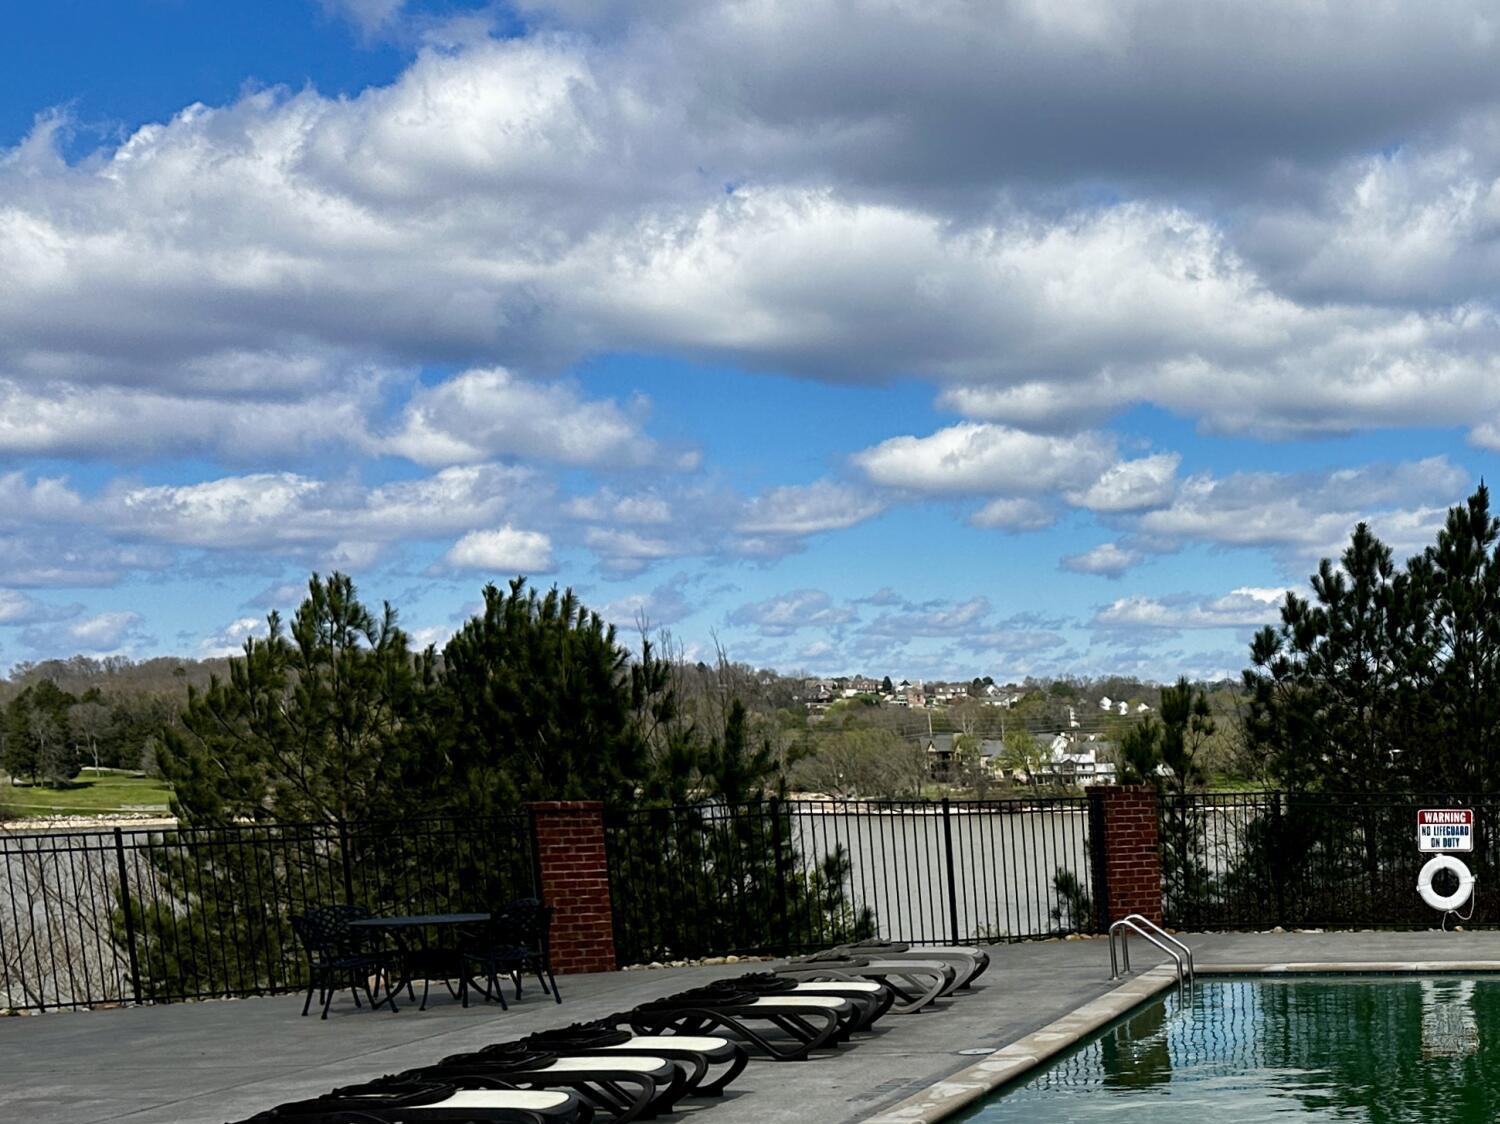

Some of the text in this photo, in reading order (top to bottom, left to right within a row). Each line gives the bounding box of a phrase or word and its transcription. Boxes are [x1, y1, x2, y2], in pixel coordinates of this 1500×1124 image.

[1424, 812, 1466, 823] WARNING
[1421, 825, 1469, 836] NO LIFEGUARD
[1431, 837, 1460, 848] ON DUTY
